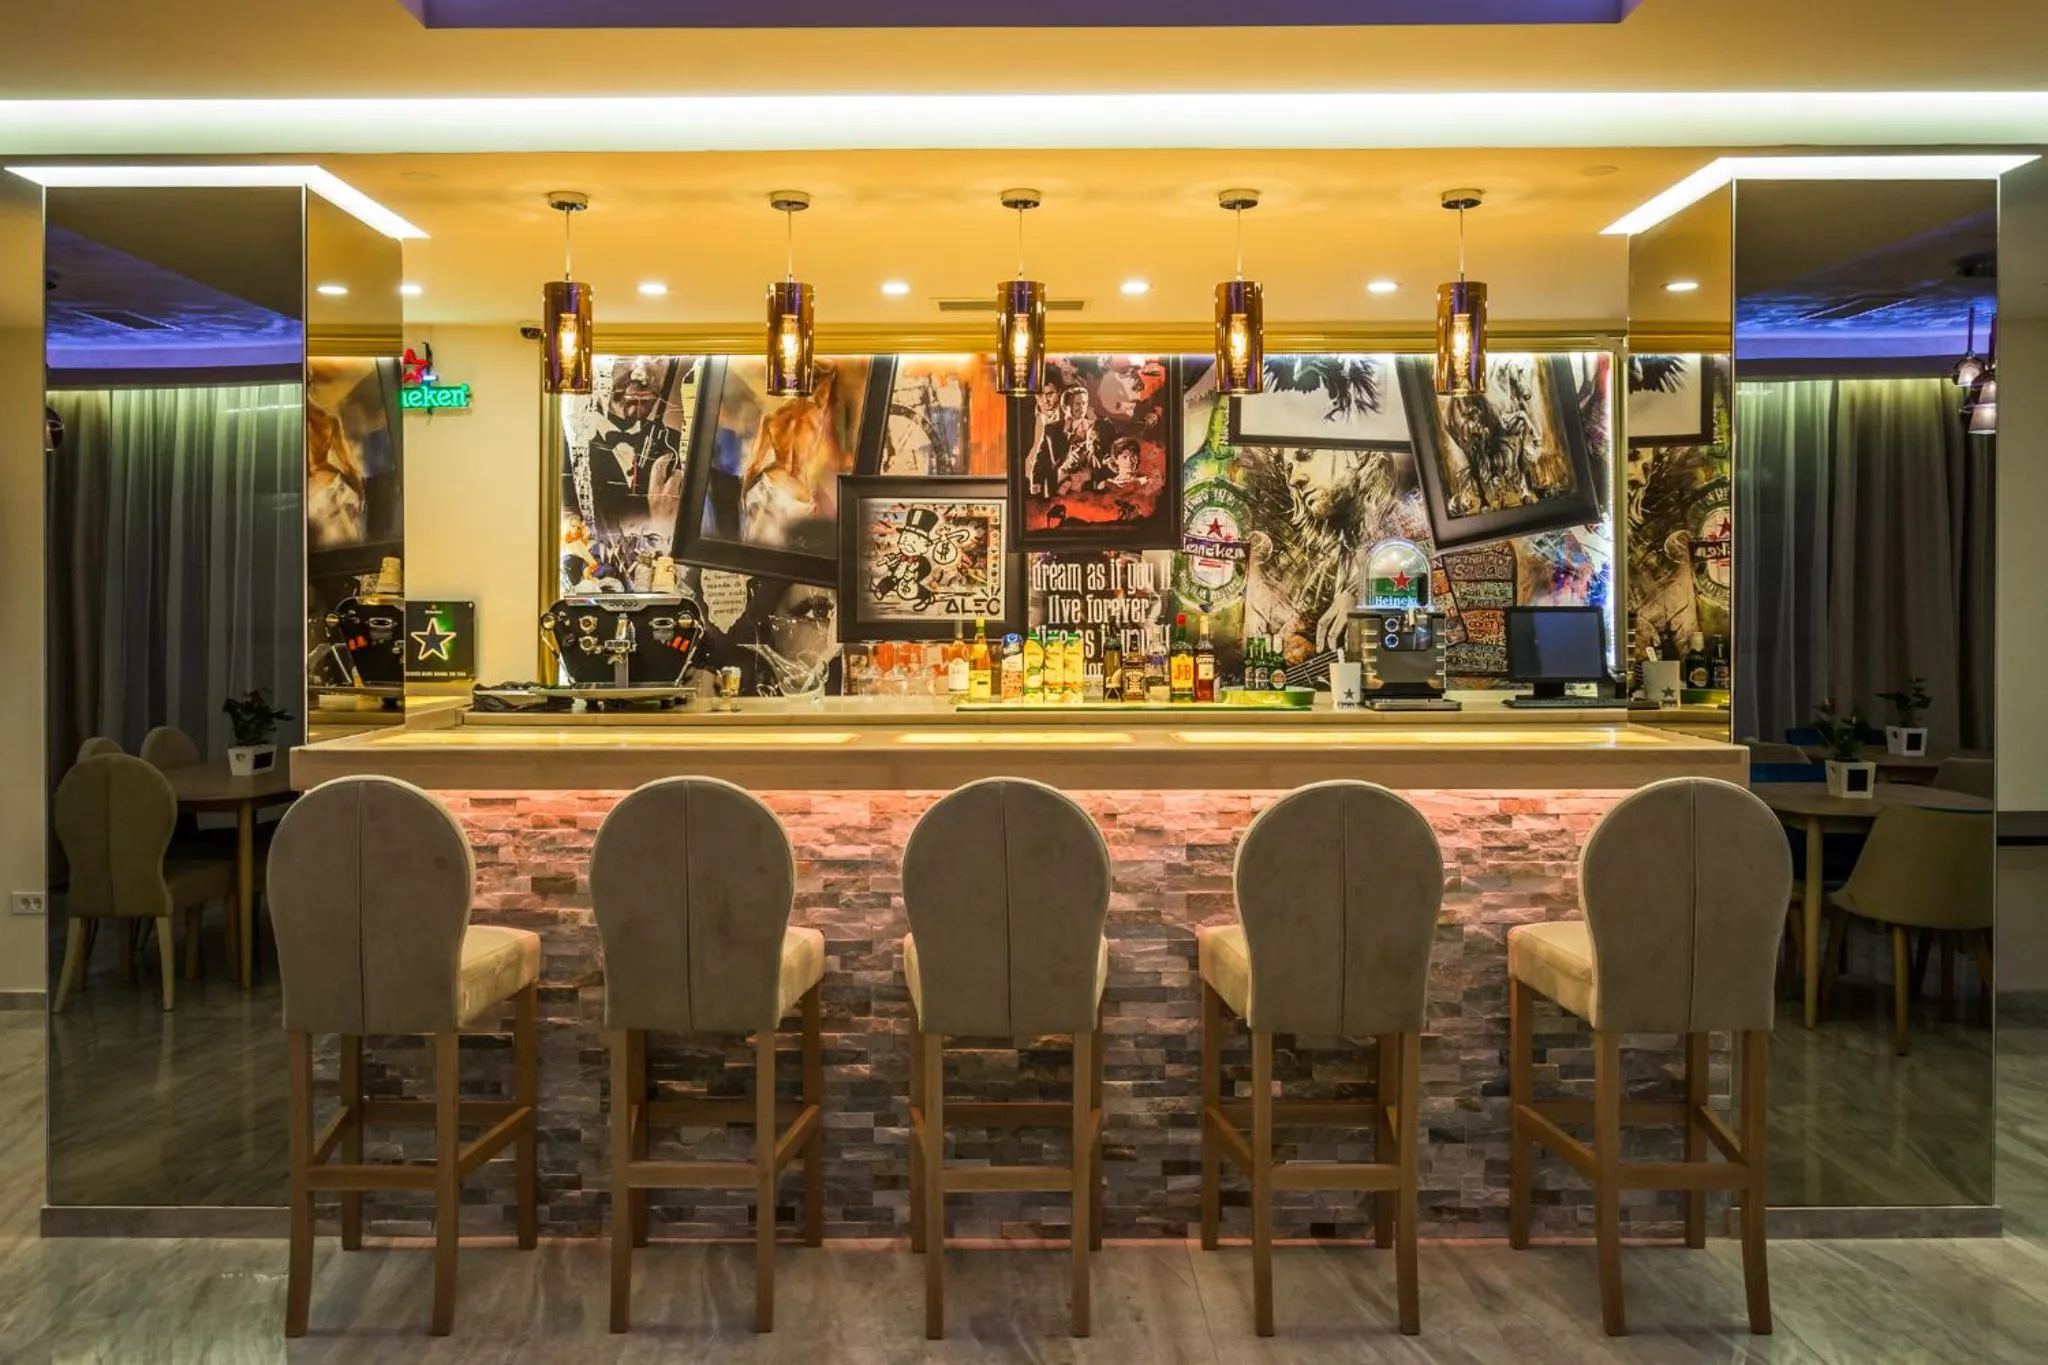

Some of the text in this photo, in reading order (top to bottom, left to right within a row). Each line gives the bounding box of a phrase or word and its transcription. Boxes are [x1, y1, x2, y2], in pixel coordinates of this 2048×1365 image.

[1032, 560, 1082, 594] dream
[1087, 563, 1105, 590] as
[1110, 558, 1121, 590] if
[946, 598, 1000, 615] ALEC
[1048, 594, 1149, 624] live forever
